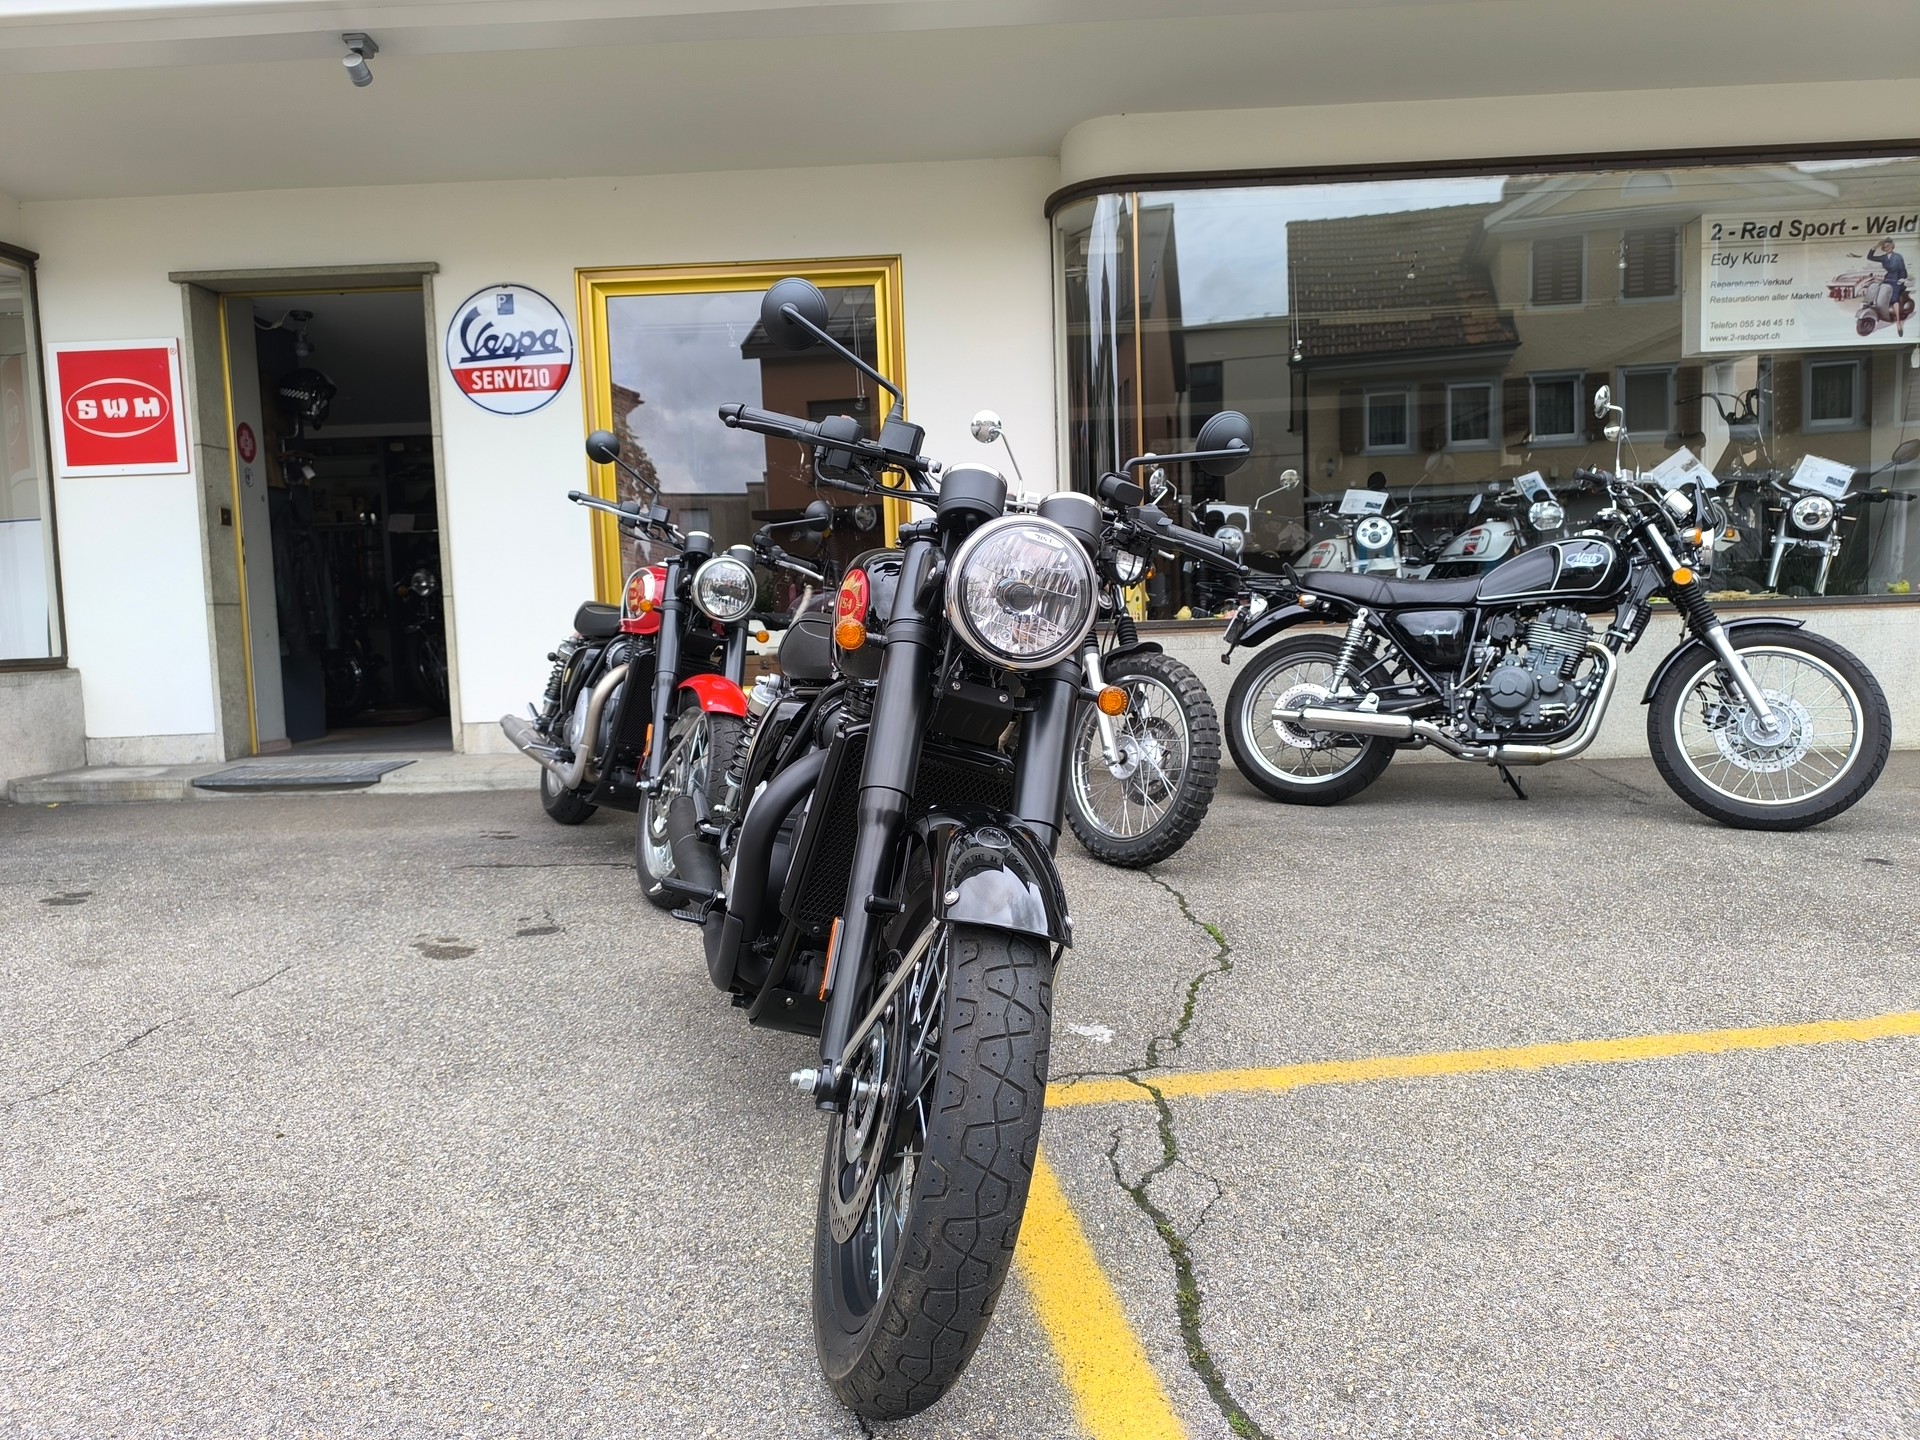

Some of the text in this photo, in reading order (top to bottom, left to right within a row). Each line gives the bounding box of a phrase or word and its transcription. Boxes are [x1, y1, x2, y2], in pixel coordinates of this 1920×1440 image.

[1711, 223, 1722, 240] 2
[1741, 221, 1783, 239] Rad
[1789, 218, 1847, 241] Sport
[1866, 214, 1919, 234] Wald
[1711, 252, 1779, 268] Edy Kunz
[1710, 278, 1793, 289] Reparaturen-Verkauf
[1710, 292, 1823, 304] Restaurationen aller Marken!
[1710, 318, 1795, 330] Telefon 055 246 45 15
[459, 306, 564, 363] Vespa
[1710, 332, 1781, 342] www.2-radsport.ch
[471, 368, 550, 390] SERVIZIO
[76, 397, 161, 420] SWM
